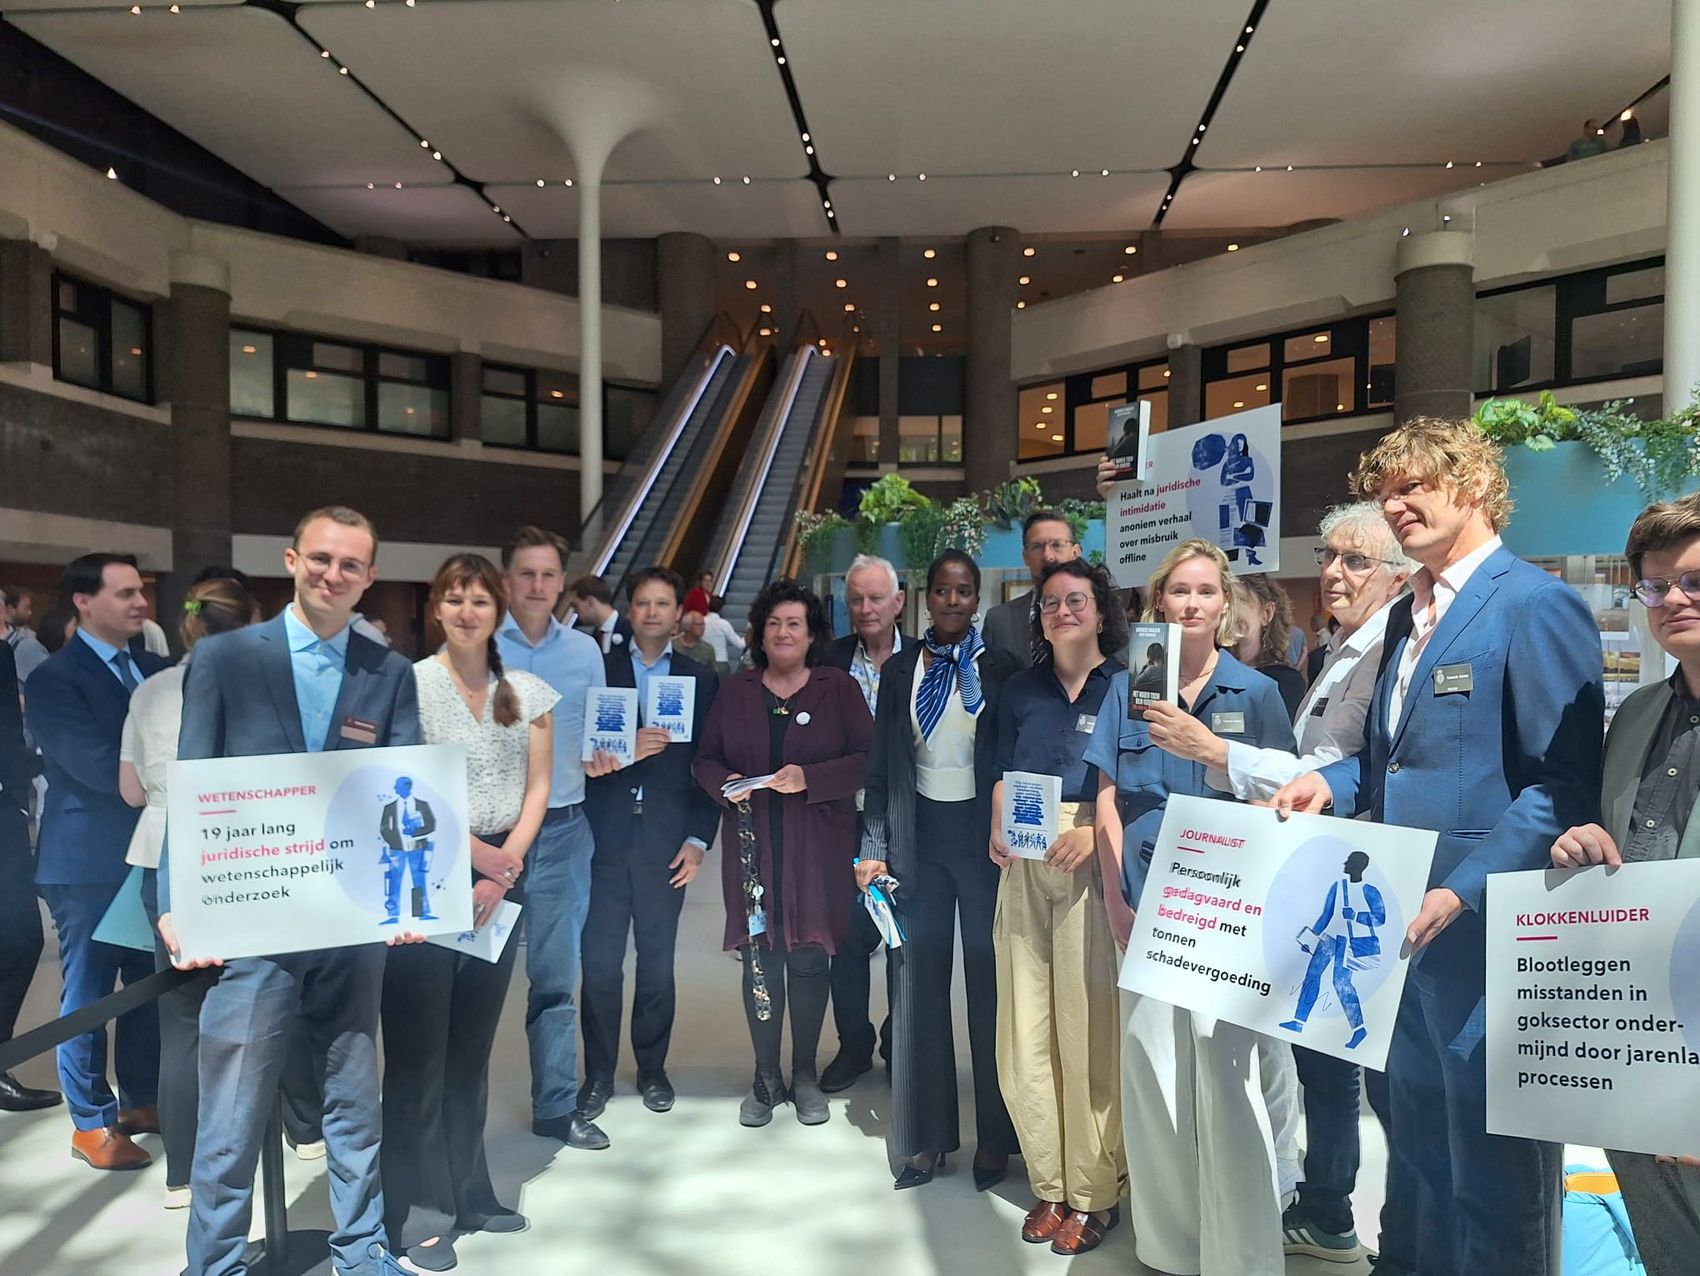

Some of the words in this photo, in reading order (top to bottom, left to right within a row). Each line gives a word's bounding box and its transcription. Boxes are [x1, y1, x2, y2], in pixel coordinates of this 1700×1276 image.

[1120, 489, 1142, 501] Haalt
[1156, 478, 1201, 496] juridische
[1120, 501, 1166, 517] intimidatie
[1119, 520, 1157, 533] anoniem
[1158, 511, 1192, 525] verhaal
[1119, 539, 1138, 549] over
[1140, 531, 1178, 545] misbruik
[1119, 553, 1146, 565] offline
[198, 785, 316, 803] WETENSCHAPPER
[201, 827, 221, 840] 19
[226, 826, 257, 842] jaar
[261, 823, 296, 836] lang
[1179, 829, 1247, 848] JOURNALIST
[201, 845, 280, 865] juridische
[284, 839, 324, 855] strijd
[329, 839, 355, 850] om
[201, 858, 345, 884] wetenschappelijk
[1169, 861, 1242, 888] Persoonlijk
[201, 886, 290, 906] onderzoek
[1161, 886, 1242, 911] gedagvaard
[1244, 904, 1262, 916] en
[1157, 904, 1217, 930] bedreigd
[1219, 921, 1248, 937] met
[1516, 908, 1650, 926] KLOKKENLUIDER
[1152, 926, 1197, 948] tonnen
[1146, 949, 1272, 997] schadevergoeding
[1517, 956, 1631, 976] Blootleggen
[1517, 984, 1623, 1001] misstanden
[1629, 984, 1648, 1001] in
[1517, 1012, 1610, 1031] goksector
[1615, 1014, 1685, 1032] onder-
[1517, 1040, 1569, 1060] mijnd
[1575, 1042, 1621, 1060] door
[1518, 1070, 1613, 1090] processen
